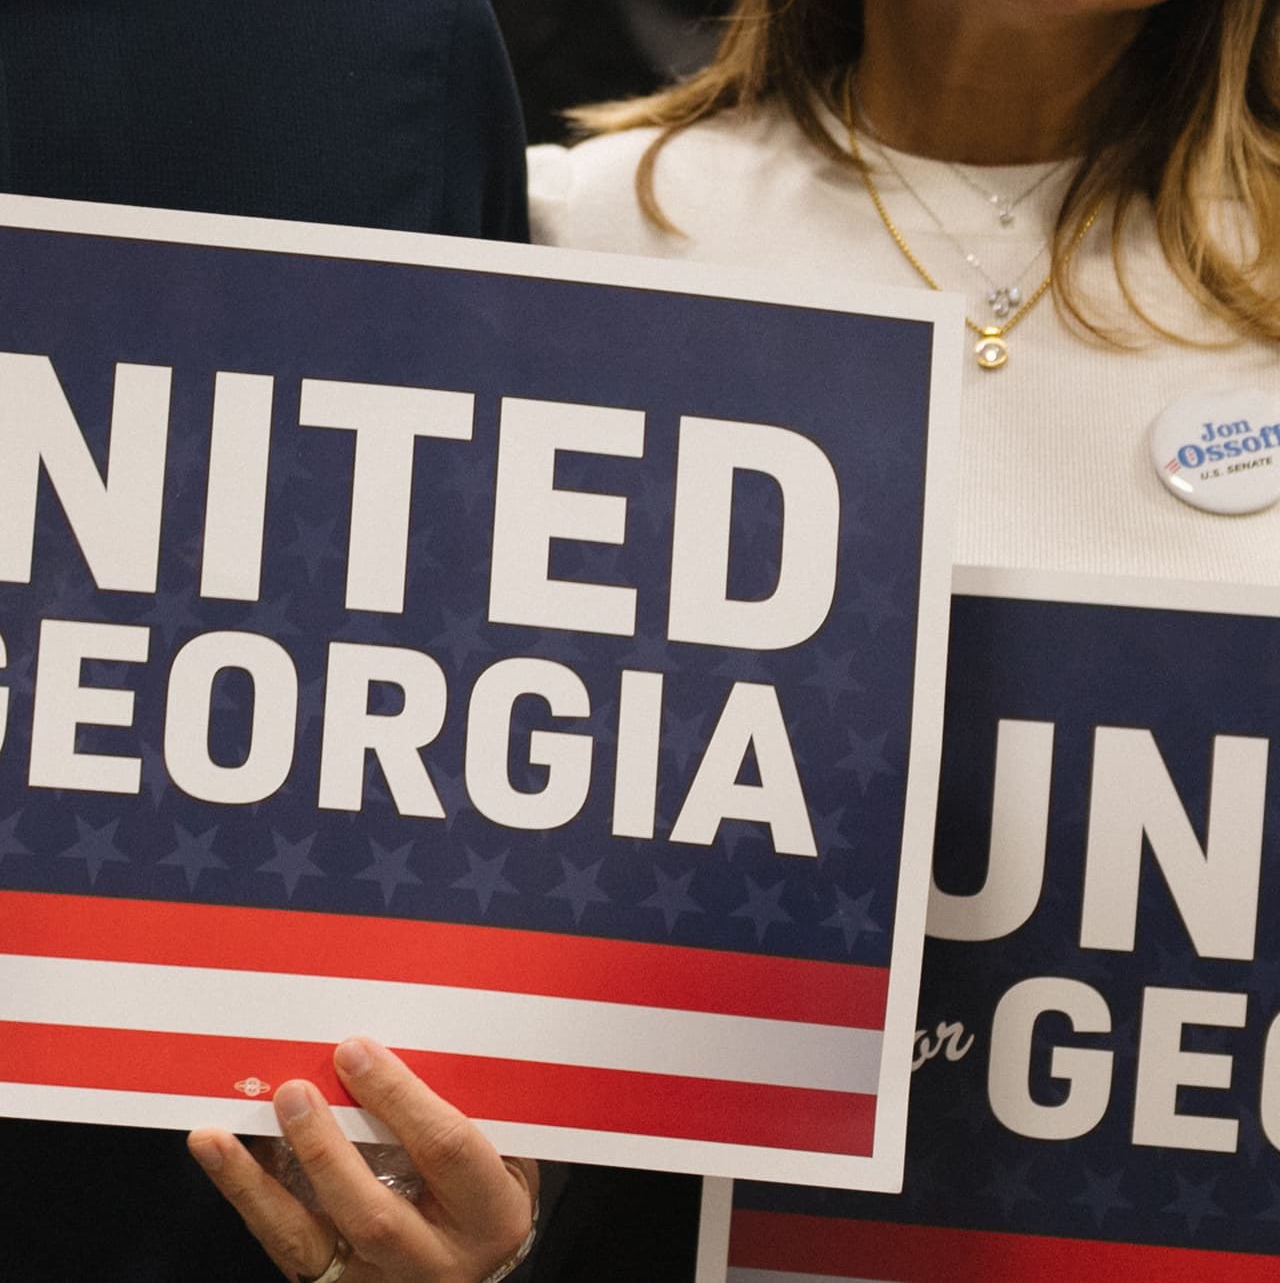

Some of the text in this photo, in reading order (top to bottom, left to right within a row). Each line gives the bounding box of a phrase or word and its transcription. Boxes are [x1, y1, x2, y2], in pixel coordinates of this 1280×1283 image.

[1201, 419, 1252, 442] Jon
[1201, 456, 1273, 481] U.S. SENATE
[911, 1020, 975, 1073] or
